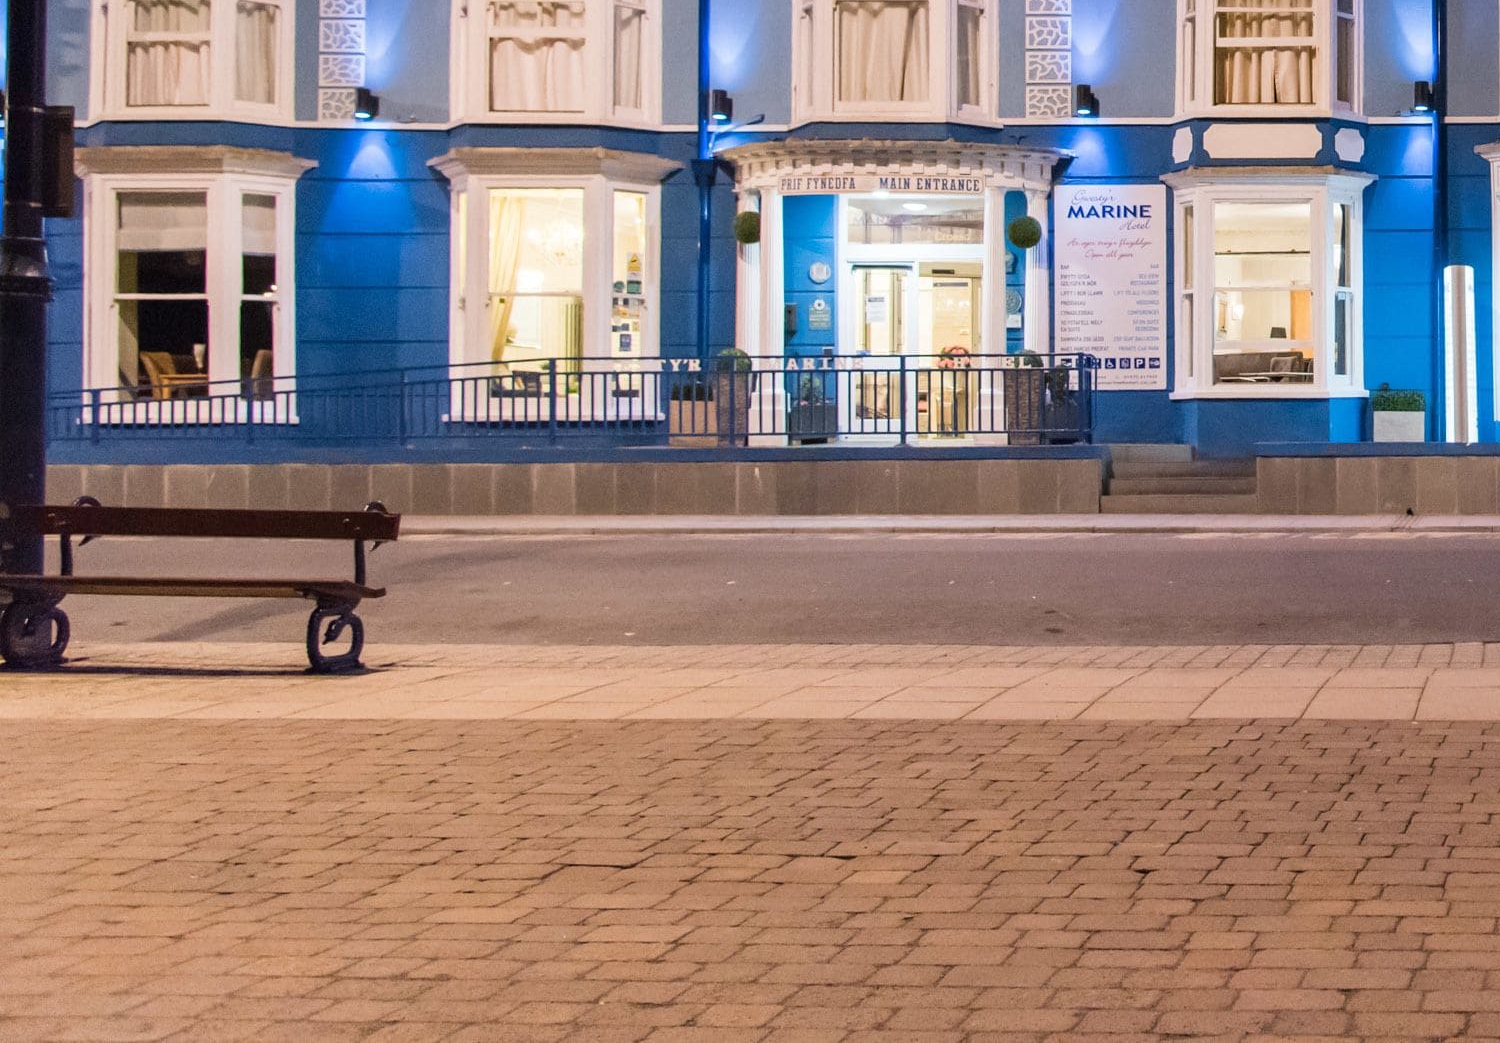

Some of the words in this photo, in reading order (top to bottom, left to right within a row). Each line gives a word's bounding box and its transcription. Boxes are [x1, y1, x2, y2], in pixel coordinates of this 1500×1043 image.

[781, 177, 804, 191] PRIF
[806, 176, 856, 190] FYNEDFA
[879, 176, 911, 190] MAIN
[916, 177, 981, 192] ENTRANCE
[1071, 188, 1115, 206] Gwesty'r
[1067, 204, 1153, 219] MARINE
[1118, 218, 1151, 231] Hotel
